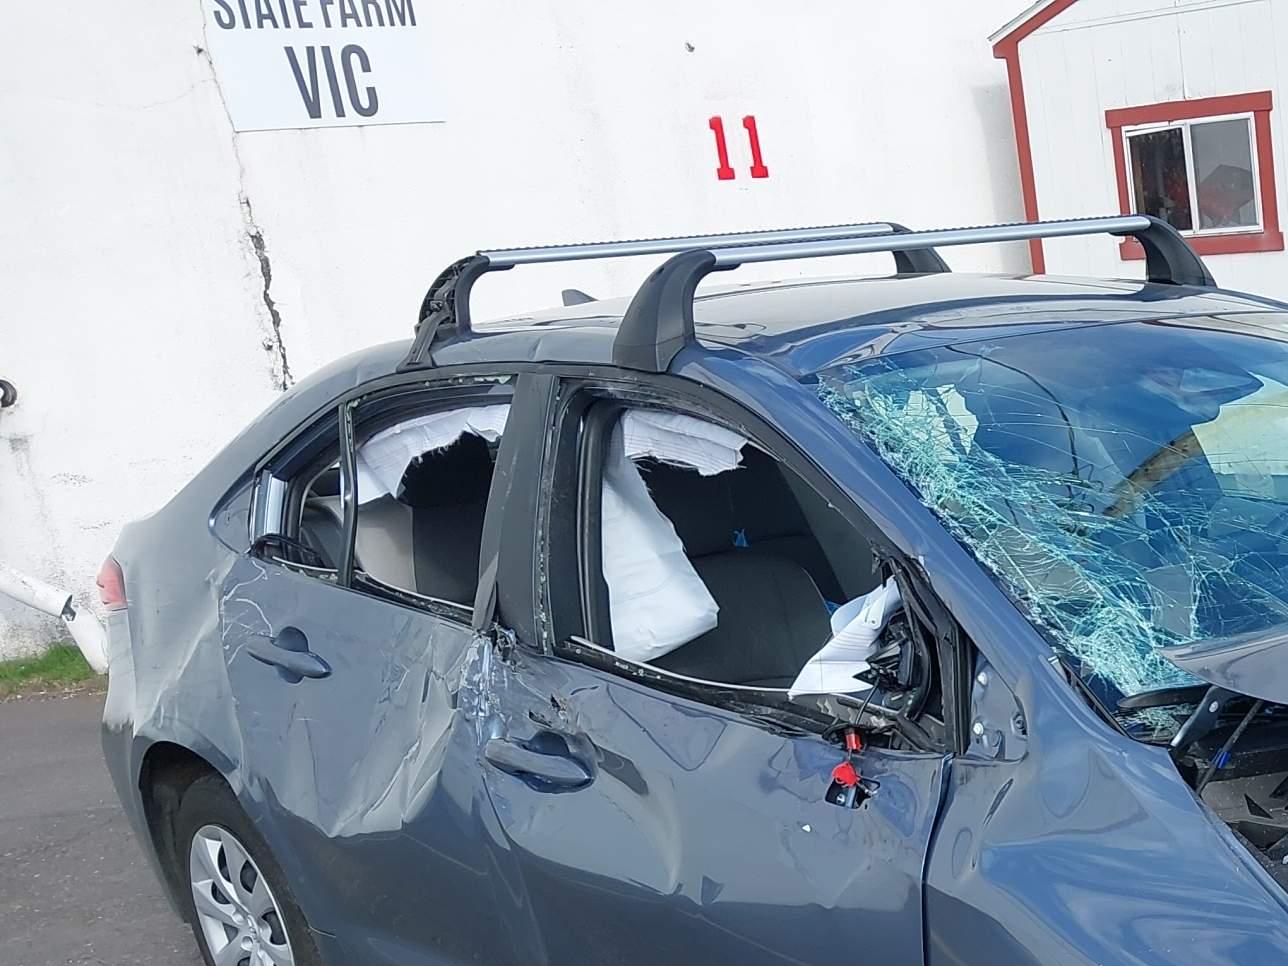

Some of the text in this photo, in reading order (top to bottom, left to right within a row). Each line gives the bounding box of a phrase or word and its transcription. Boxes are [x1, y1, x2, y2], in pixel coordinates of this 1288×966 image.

[214, 0, 416, 30] STATE FARM
[284, 44, 379, 119] VIC
[709, 115, 769, 180] 11
